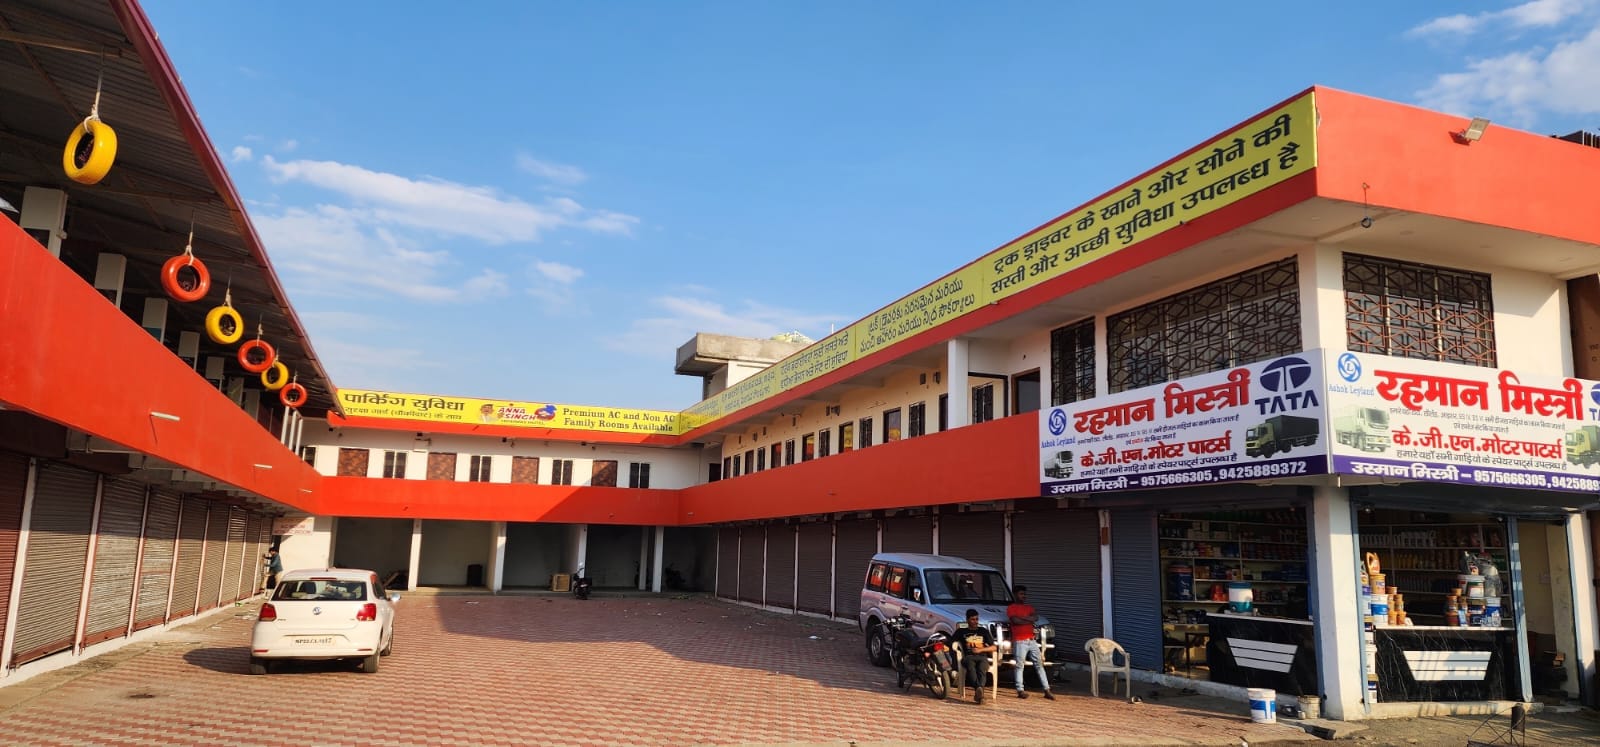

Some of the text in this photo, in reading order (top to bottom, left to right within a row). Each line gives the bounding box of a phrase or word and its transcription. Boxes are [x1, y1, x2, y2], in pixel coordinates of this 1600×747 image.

[993, 113, 1292, 274] ट्रक ड्राइवर के खाने और सोने की
[991, 141, 1300, 294] सस्ती और अच्छी सुविधा उपलब्ध है
[1073, 367, 1252, 435] रहमान मिस्त्री
[1255, 389, 1319, 415] TATA
[1328, 383, 1374, 397] Ashok Leyland
[1374, 369, 1584, 420] रहमान मिस्त्री
[411, 398, 465, 411] सुविधा
[563, 408, 675, 423] Premium AC and Non AC
[564, 417, 673, 432] Family Rooms Available
[1230, 452, 1238, 462] है
[1396, 449, 1418, 459] हमारे
[1435, 450, 1453, 460] सभी
[1482, 455, 1490, 464] के
[1491, 456, 1513, 466] स्पेयर
[1051, 482, 1089, 494] उस्मान
[1089, 477, 1128, 491] मिस्त्री
[1219, 461, 1307, 480] 9425889372
[1350, 461, 1410, 477] उस्मान
[1410, 463, 1460, 481] मिस्त्री
[1551, 476, 1600, 491] 9425889
